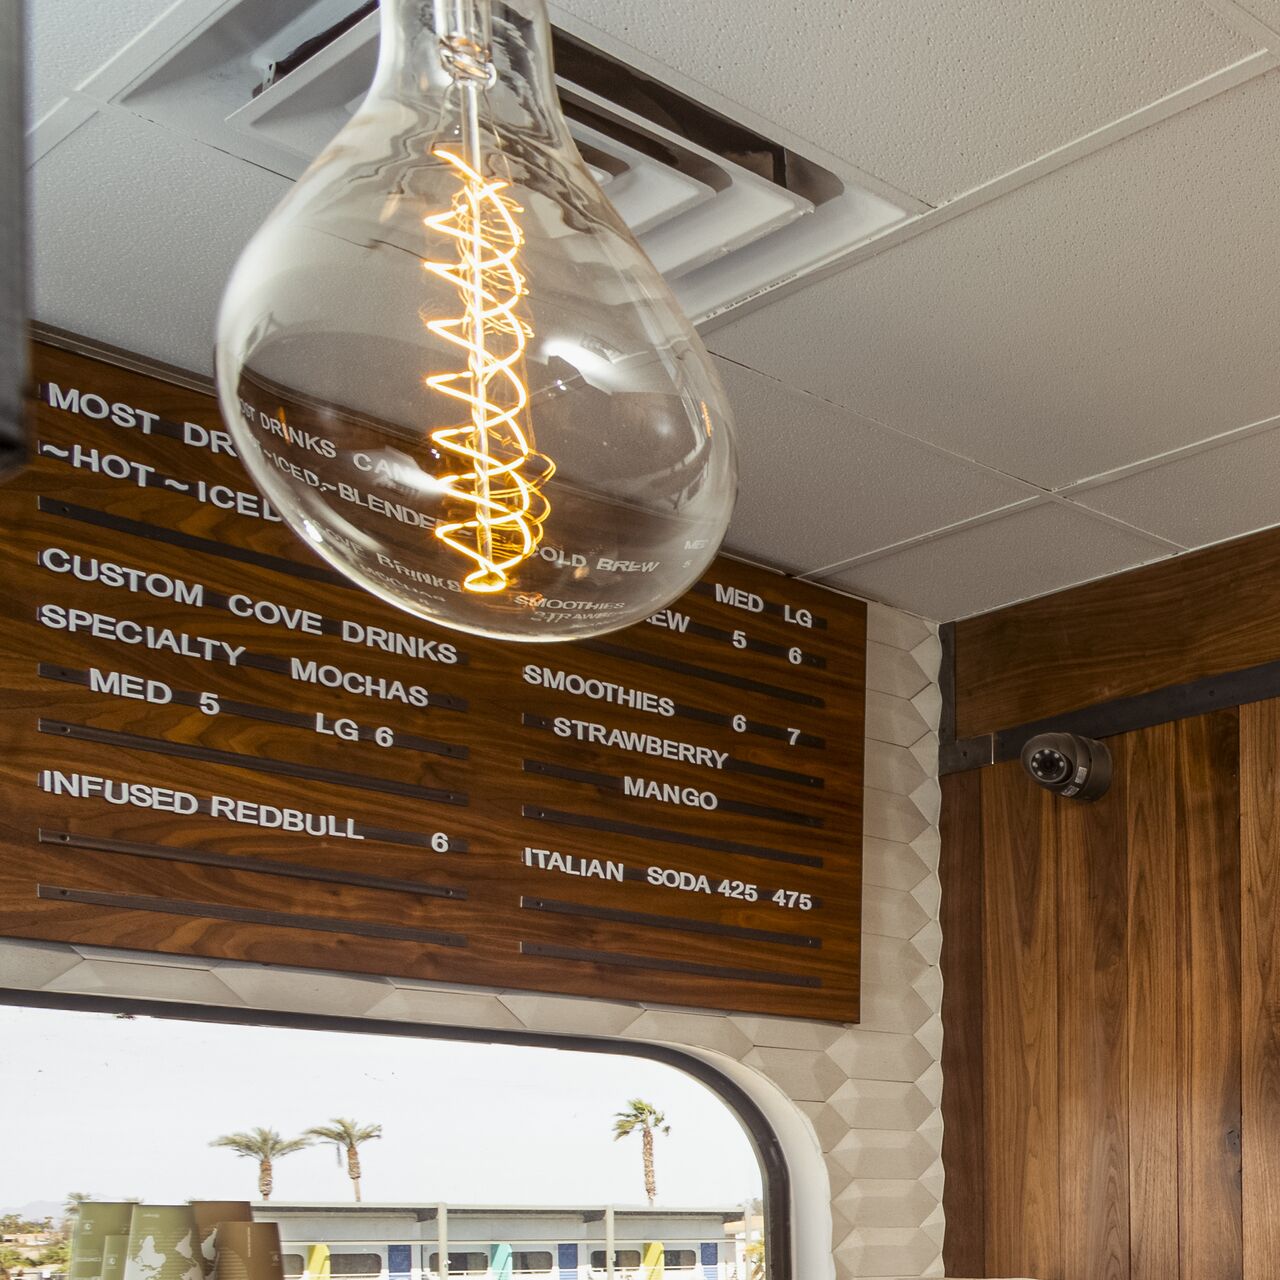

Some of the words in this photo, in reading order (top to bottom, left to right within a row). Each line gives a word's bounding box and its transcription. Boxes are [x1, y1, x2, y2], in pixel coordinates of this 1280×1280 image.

[48, 382, 160, 435] MOST
[42, 548, 203, 607] CUSTOM
[228, 594, 323, 635] COVE
[341, 620, 458, 664] DRINKS
[715, 583, 764, 613] MED
[784, 605, 813, 628] LG
[41, 603, 246, 666] SPECIALTY
[290, 657, 429, 707] MOCHAS
[732, 631, 747, 649] 5
[788, 647, 802, 664] 6
[89, 667, 173, 704] MED
[199, 692, 220, 715] 5
[315, 712, 359, 741] LG
[374, 726, 395, 748] 6
[523, 664, 675, 717] SMOOTHIES
[732, 714, 747, 732] 6
[787, 728, 801, 746] 7
[553, 717, 729, 769] STRAWBERRY
[42, 769, 199, 815] INFUSED
[210, 795, 364, 840] REDBULL
[430, 831, 449, 853] 6
[624, 776, 718, 810] MANGO
[524, 847, 624, 882] ITALIAN
[647, 866, 711, 893] SODA
[717, 879, 758, 902] 425
[772, 889, 812, 910] 475
